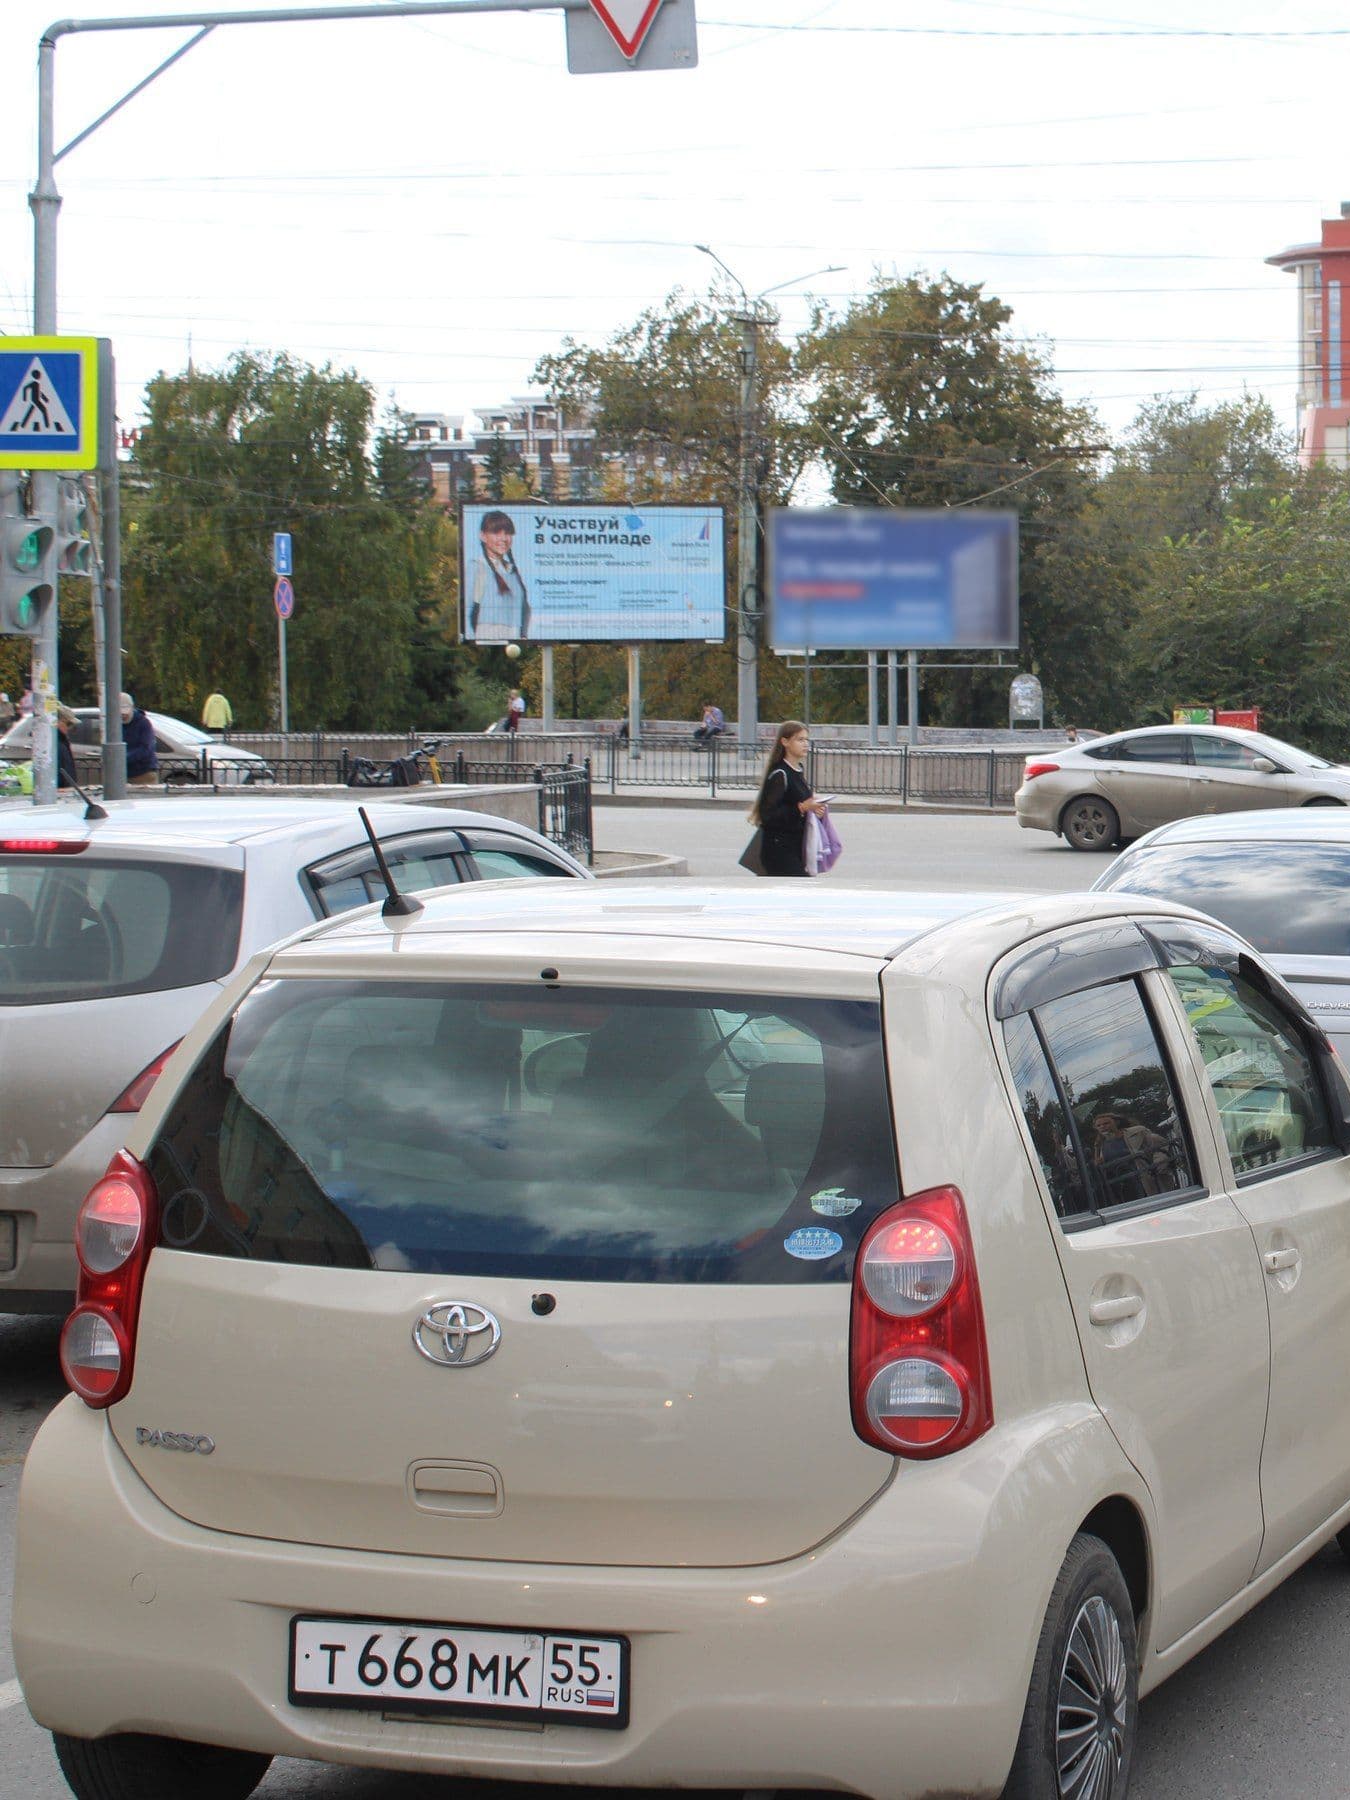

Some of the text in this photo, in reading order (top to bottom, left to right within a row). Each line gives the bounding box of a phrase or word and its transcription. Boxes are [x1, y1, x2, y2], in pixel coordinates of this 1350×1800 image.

[535, 515, 620, 532] Участвуй
[534, 533, 652, 546] в олимпиаде
[136, 1426, 216, 1455] PASSO
[550, 1643, 600, 1686] 55
[547, 1686, 585, 1704] RUS
